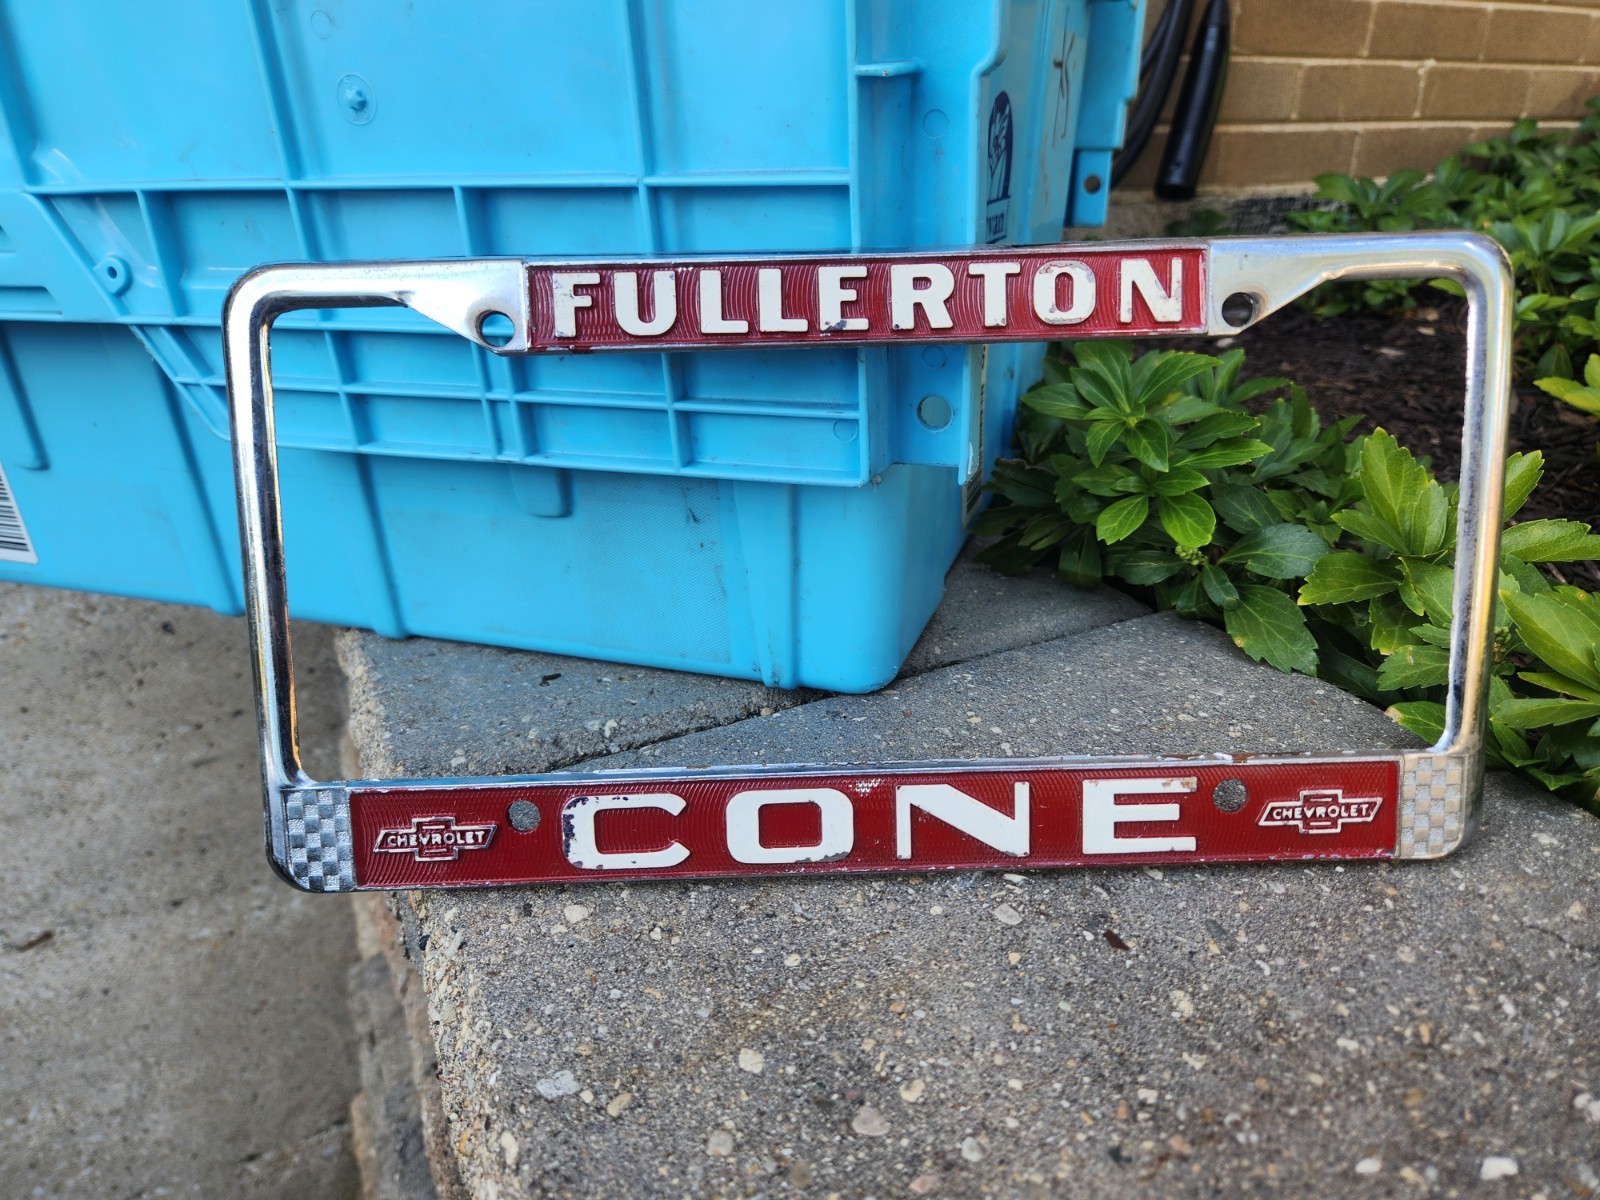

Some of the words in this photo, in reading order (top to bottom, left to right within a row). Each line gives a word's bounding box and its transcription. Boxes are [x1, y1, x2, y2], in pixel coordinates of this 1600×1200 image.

[551, 257, 1184, 339] FULLERTON
[563, 776, 1198, 870] CONE
[1272, 804, 1369, 820] CHEVROLET
[387, 831, 485, 847] CHEVROLET
